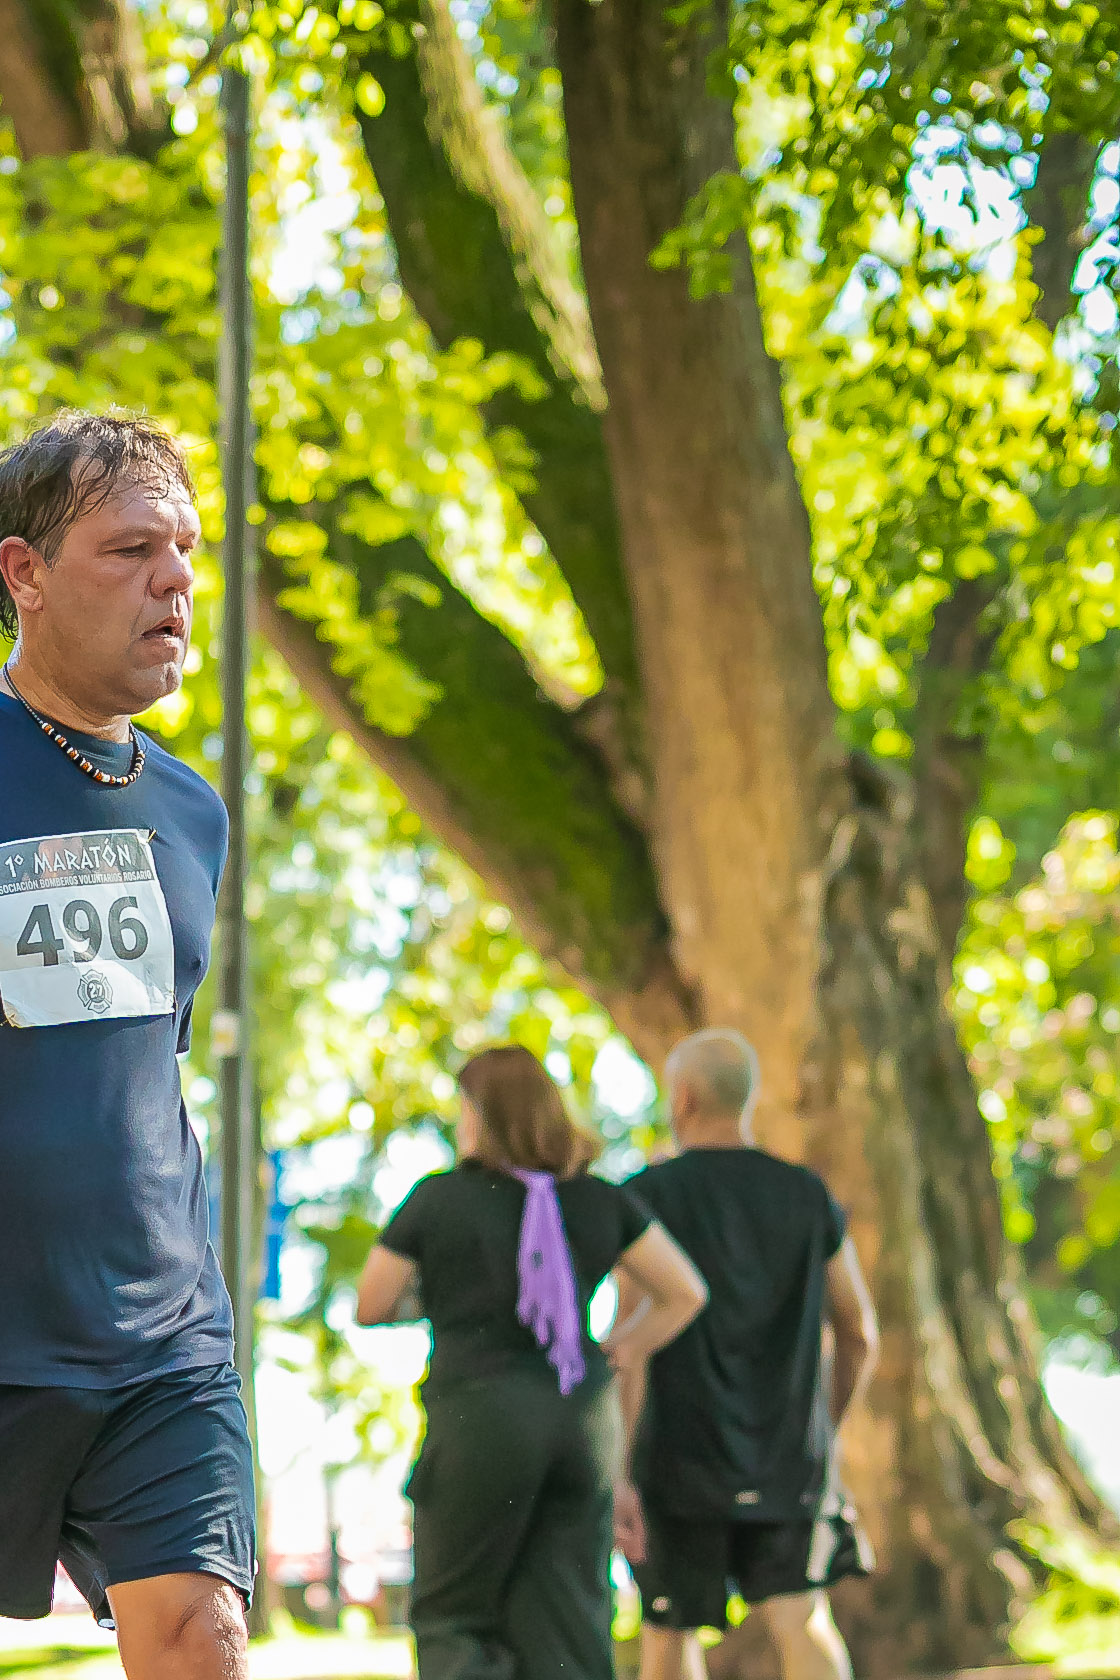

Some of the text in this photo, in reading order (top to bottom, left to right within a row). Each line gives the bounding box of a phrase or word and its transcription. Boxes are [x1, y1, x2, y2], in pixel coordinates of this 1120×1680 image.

[33, 837, 132, 875] MARATÓN
[40, 874, 79, 889] BOMBEROS
[79, 871, 122, 886] VOLUNTARIOS
[123, 869, 152, 882] ROSARIO
[16, 896, 149, 967] 496
